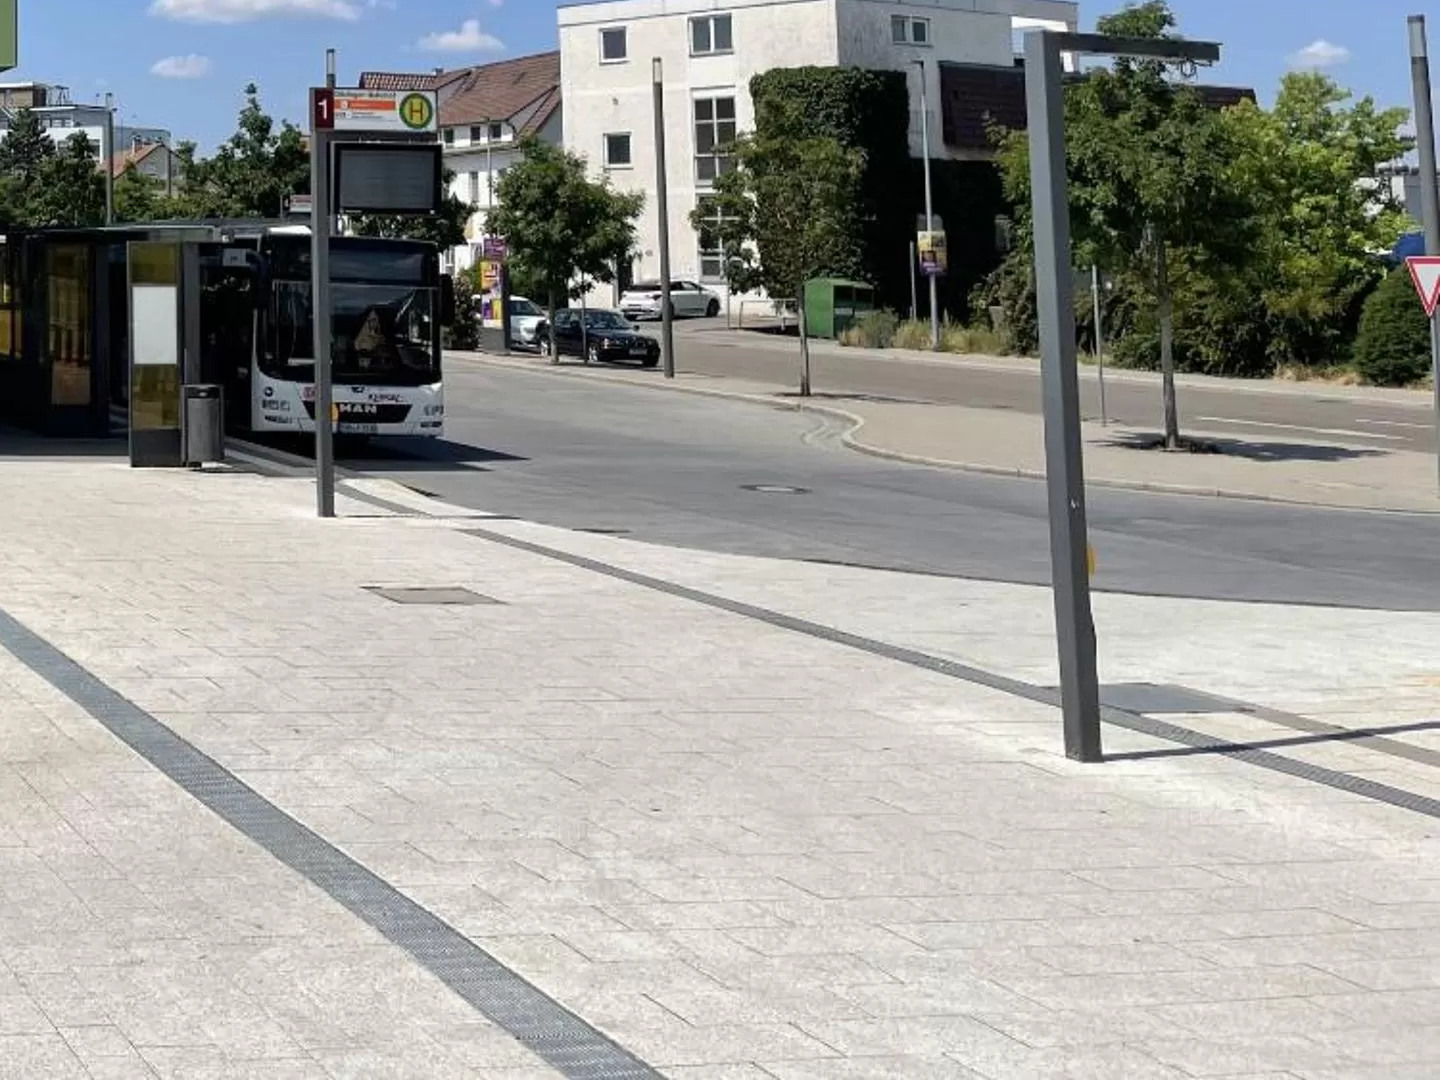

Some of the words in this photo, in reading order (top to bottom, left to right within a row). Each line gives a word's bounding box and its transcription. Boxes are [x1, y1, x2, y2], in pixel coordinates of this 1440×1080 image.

[317, 98, 328, 120] 1
[408, 100, 424, 121] H
[339, 403, 377, 414] MAN
